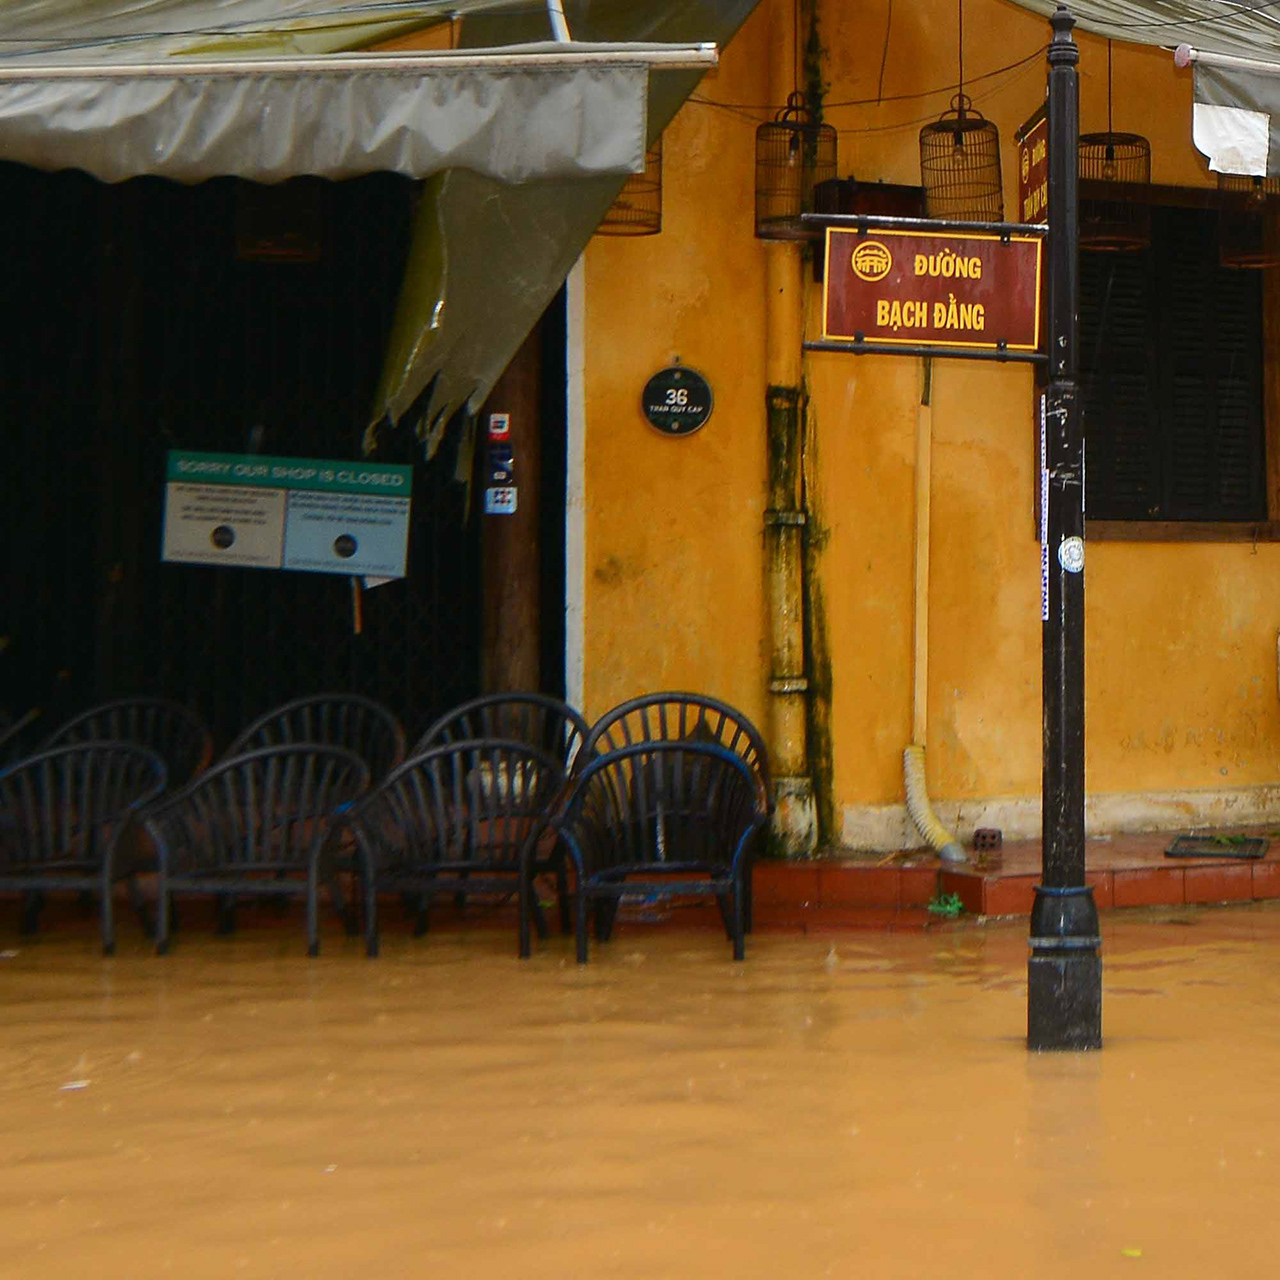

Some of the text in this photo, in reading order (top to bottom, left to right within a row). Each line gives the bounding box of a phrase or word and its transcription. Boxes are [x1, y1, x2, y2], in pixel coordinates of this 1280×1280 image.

[914, 248, 982, 279] ĐƯỜNG
[876, 292, 985, 331] BẠCH ĐẰNG
[665, 389, 688, 405] 36
[177, 460, 404, 487] SORRY OUR SHOP IS CLOSED
